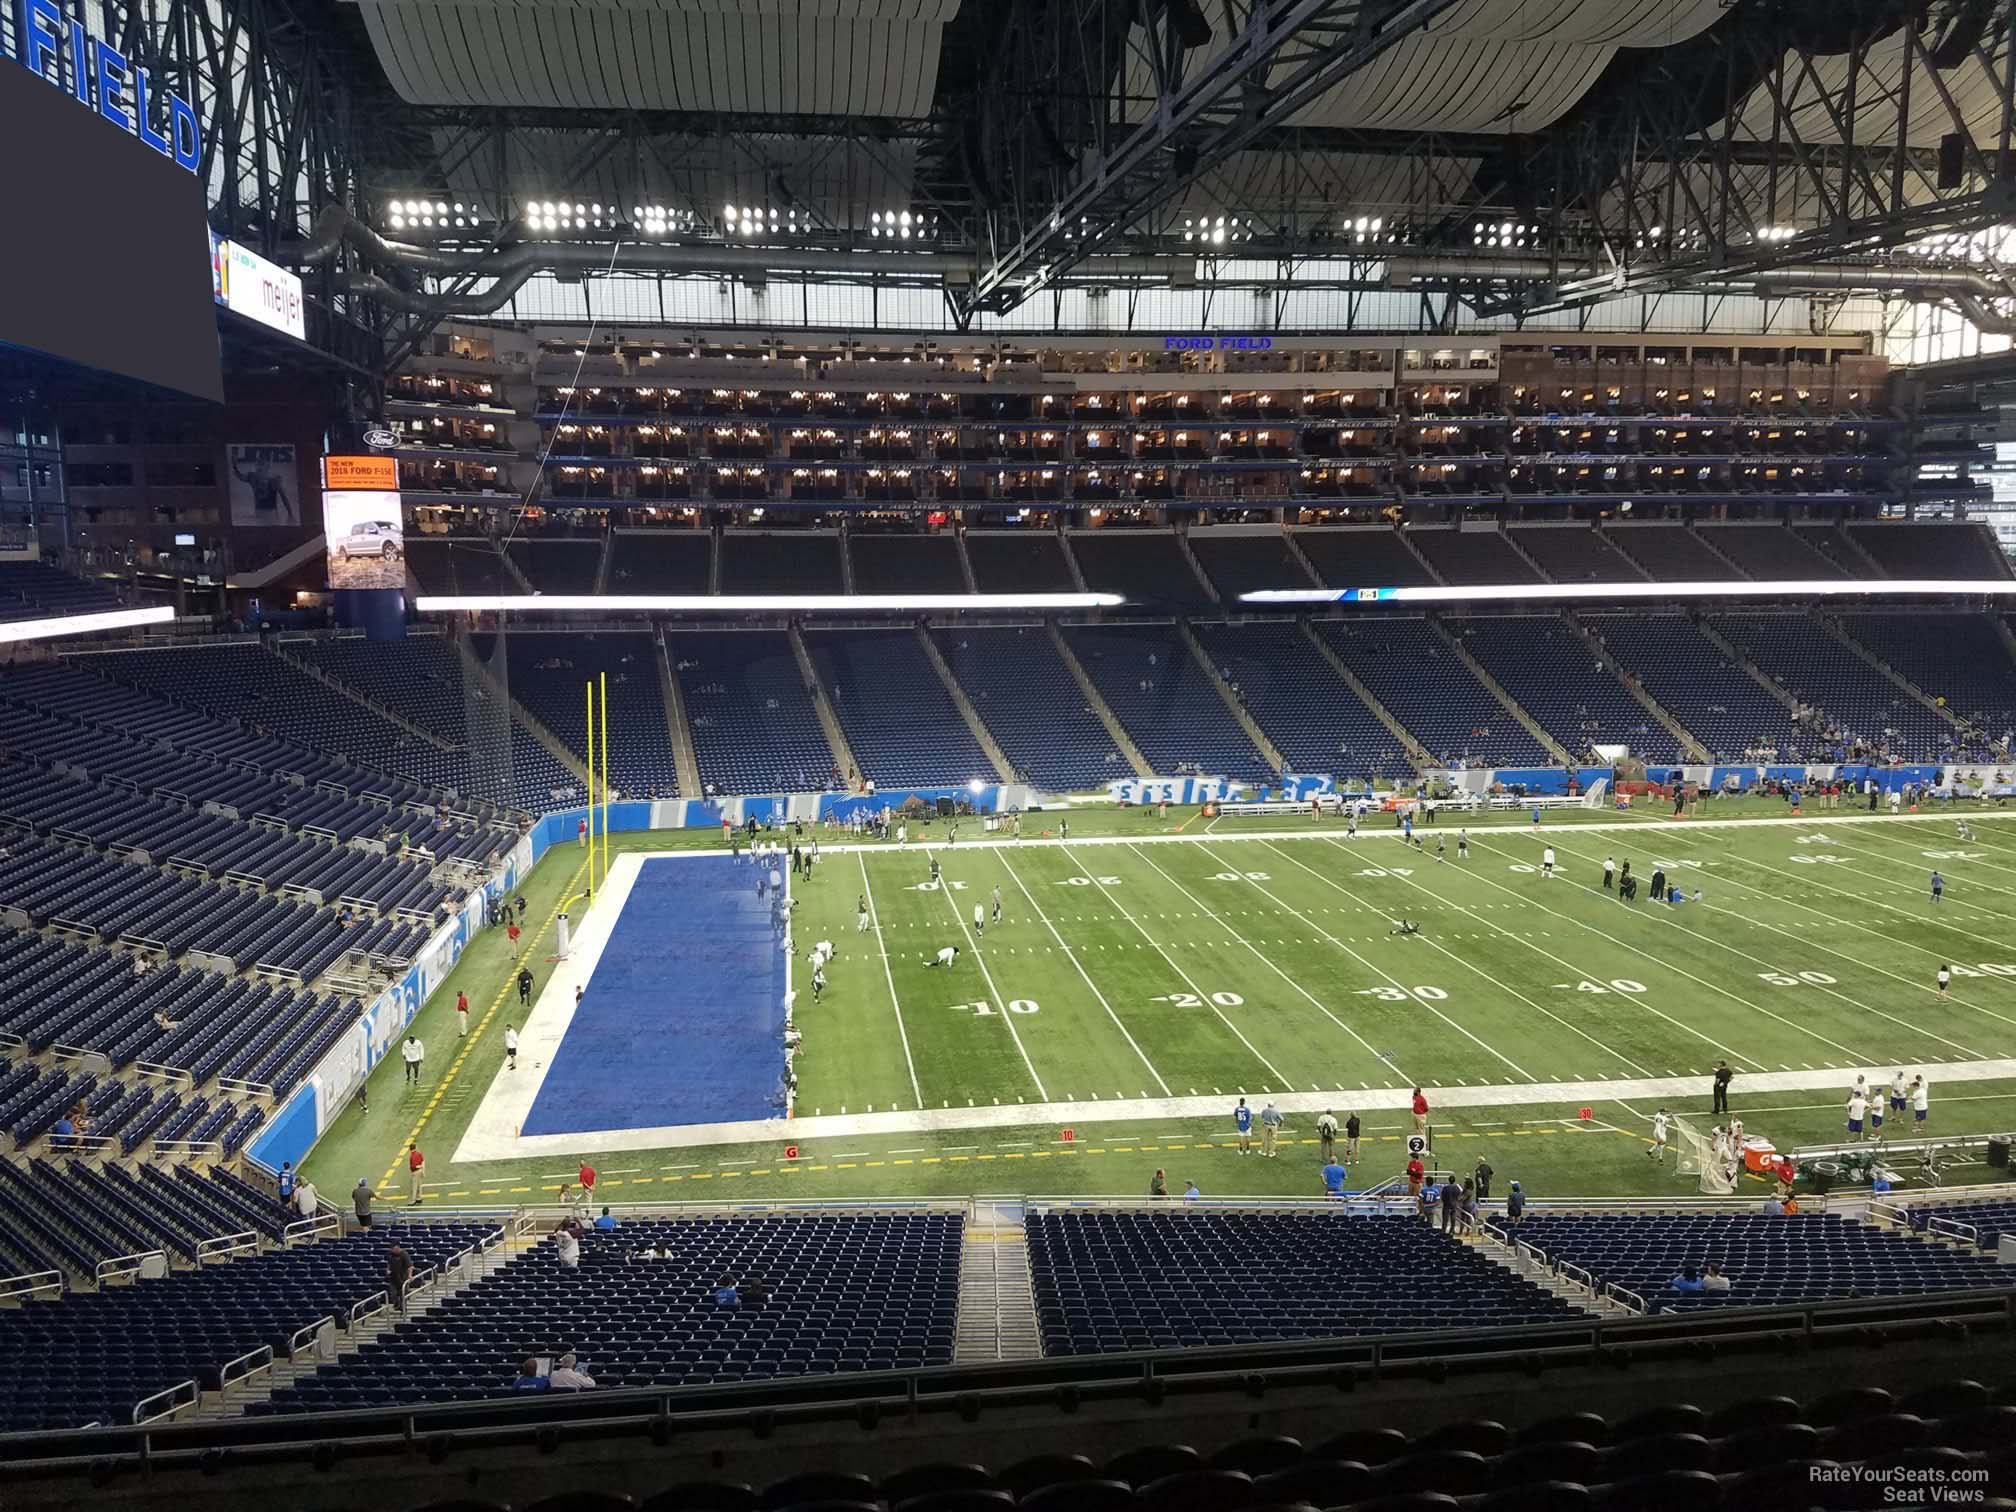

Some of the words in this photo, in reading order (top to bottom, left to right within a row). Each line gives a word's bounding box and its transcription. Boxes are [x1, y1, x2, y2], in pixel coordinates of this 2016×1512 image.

[25, 0, 201, 172] FIELD
[262, 277, 300, 326] meijer
[1164, 336, 1214, 350] FORD
[1221, 336, 1272, 349] FIELD
[370, 432, 394, 445] Ford
[351, 467, 372, 475] FORD
[1215, 872, 1271, 881] 30
[1362, 868, 1415, 876] 40
[917, 881, 968, 891] 10
[1068, 876, 1122, 886] 20
[1951, 963, 2016, 977] 40
[1757, 971, 1837, 986] 50
[1577, 979, 1648, 993] 40
[1370, 986, 1448, 1000] 30
[1168, 992, 1244, 1007] 20
[967, 1000, 1040, 1015] 10
[1238, 1111, 1246, 1121] 85
[1582, 1108, 1591, 1118] 30
[1064, 1130, 1072, 1141] 10
[1414, 1142, 1420, 1150] 2
[786, 1147, 796, 1158] G
[1760, 1154, 1770, 1166] G
